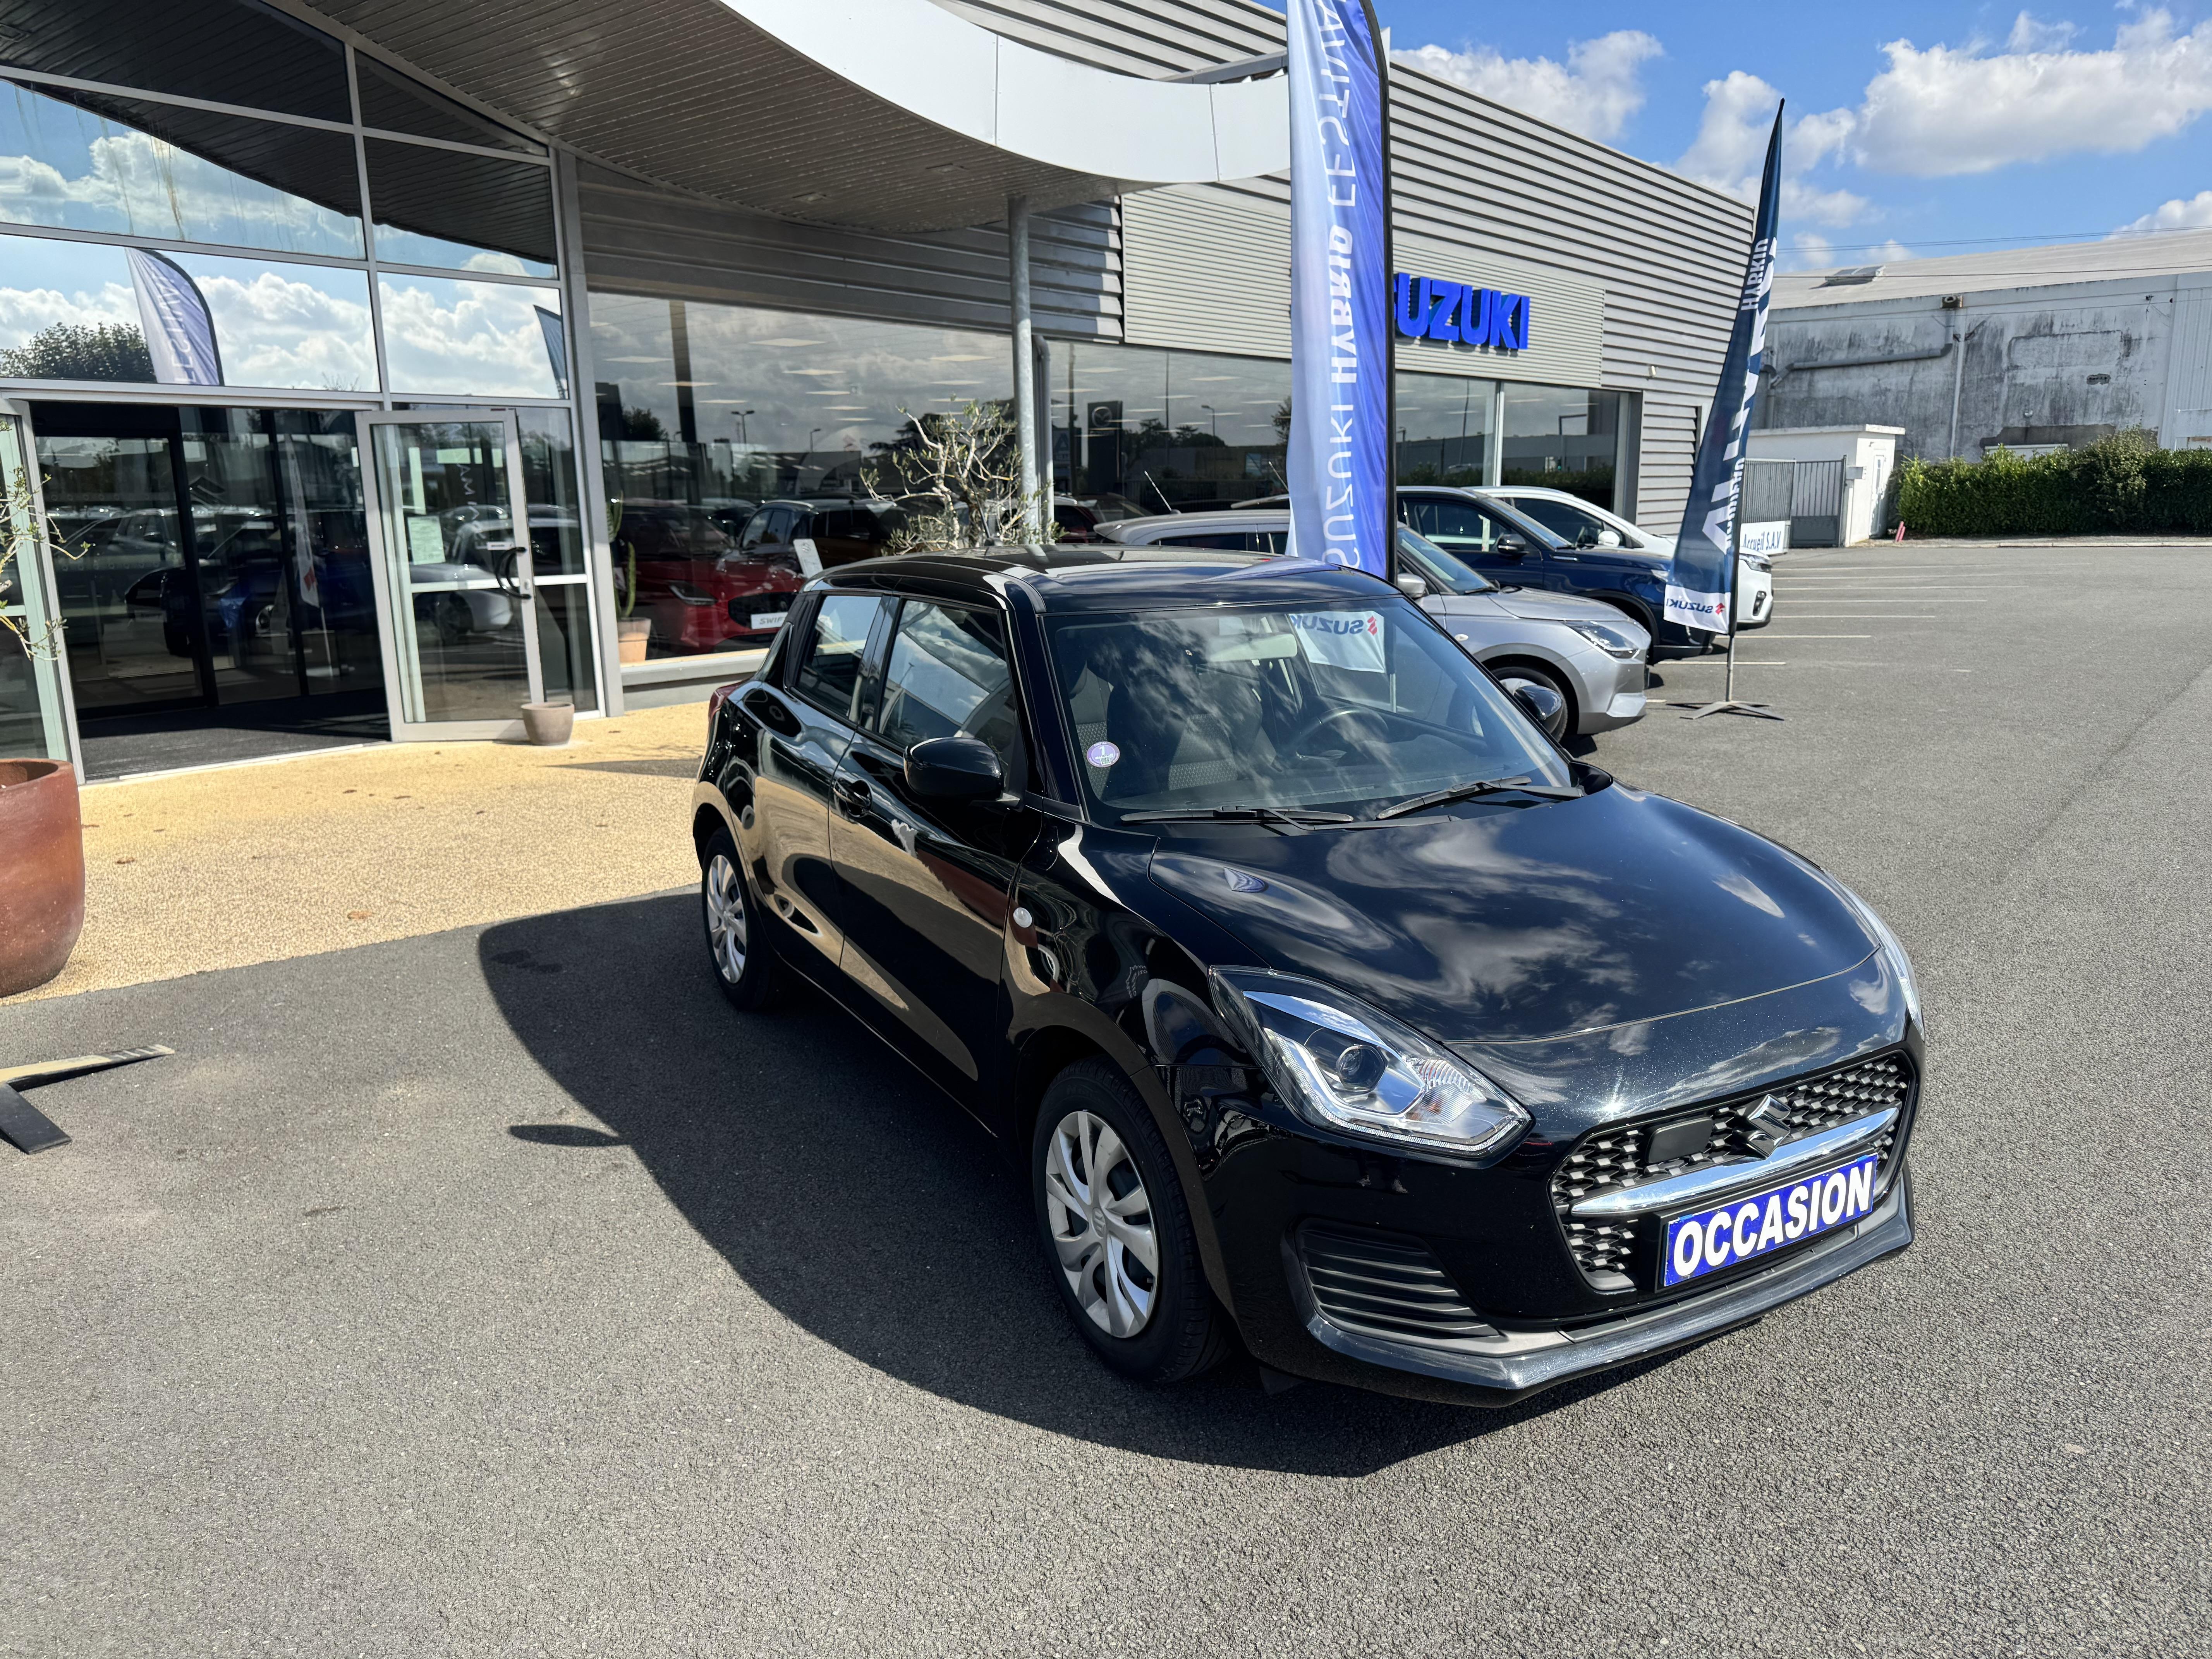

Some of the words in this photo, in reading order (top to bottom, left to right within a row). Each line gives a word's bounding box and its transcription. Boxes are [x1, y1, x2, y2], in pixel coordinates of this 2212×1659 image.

[1394, 272, 1531, 350] UZUKI
[1743, 531, 1765, 552] Accueil
[759, 617, 784, 625] SWIF
[1099, 745, 1106, 756] 1
[1673, 1161, 1873, 1277] OCCASION
